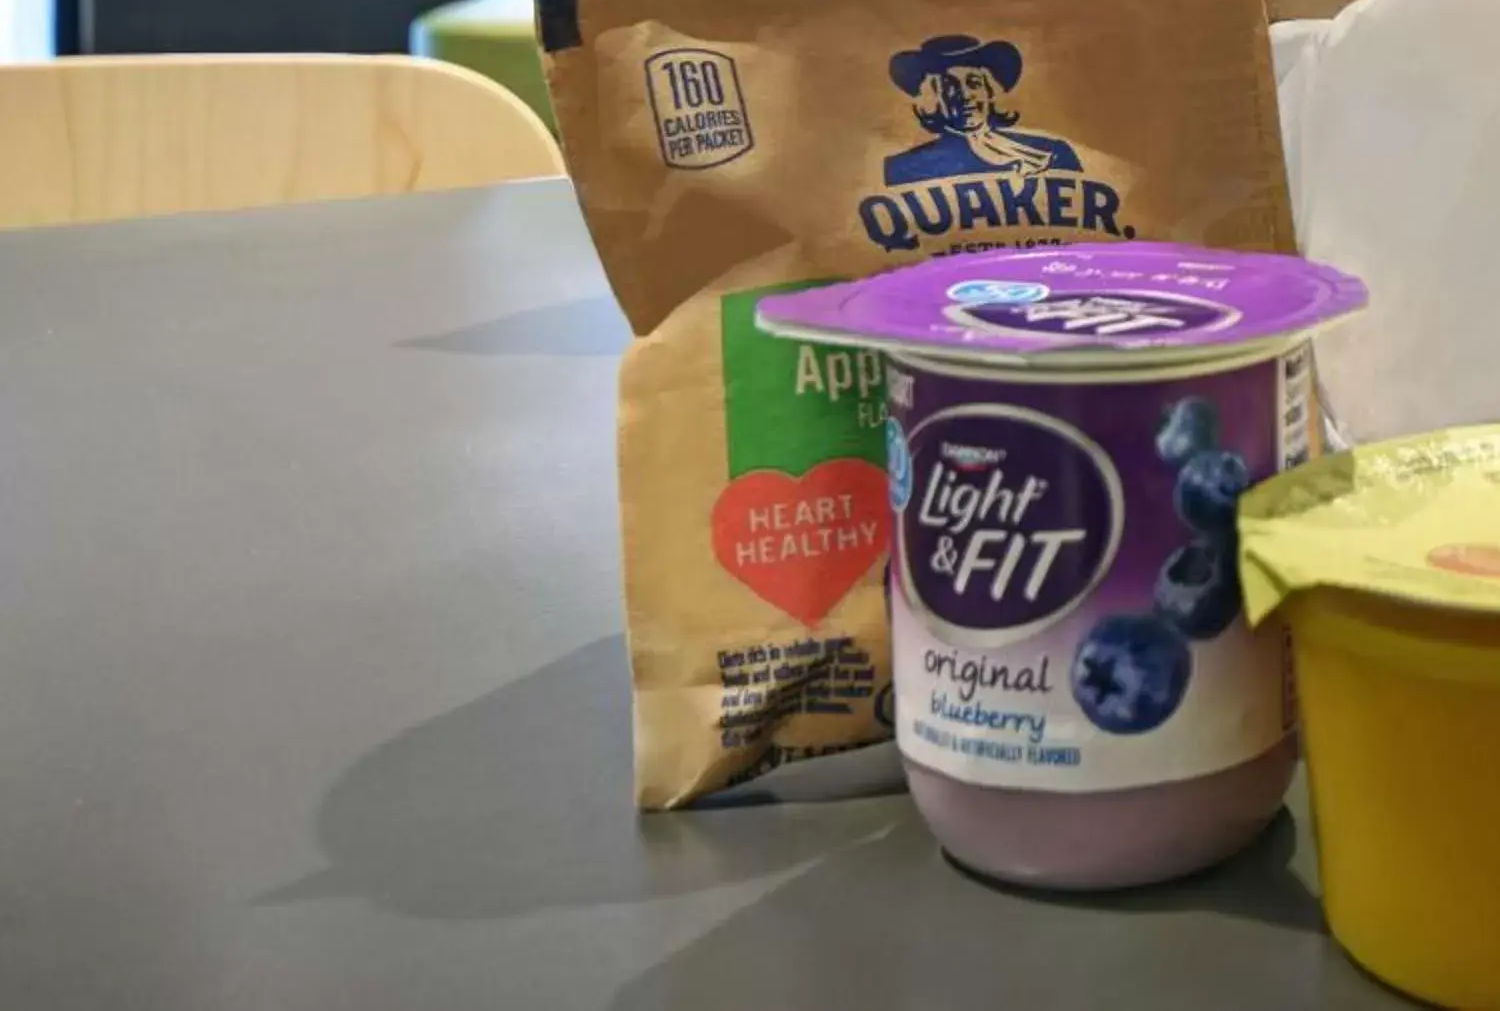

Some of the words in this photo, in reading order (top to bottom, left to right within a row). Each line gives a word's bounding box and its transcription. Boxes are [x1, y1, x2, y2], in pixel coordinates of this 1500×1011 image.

[661, 60, 725, 110] 160
[663, 109, 741, 137] CALORIES
[795, 344, 883, 401] App
[749, 494, 852, 533] HEART
[918, 461, 1046, 535] Light
[735, 521, 878, 567] HEALTHY
[924, 649, 1053, 702] original
[930, 689, 1047, 743] blueberry
